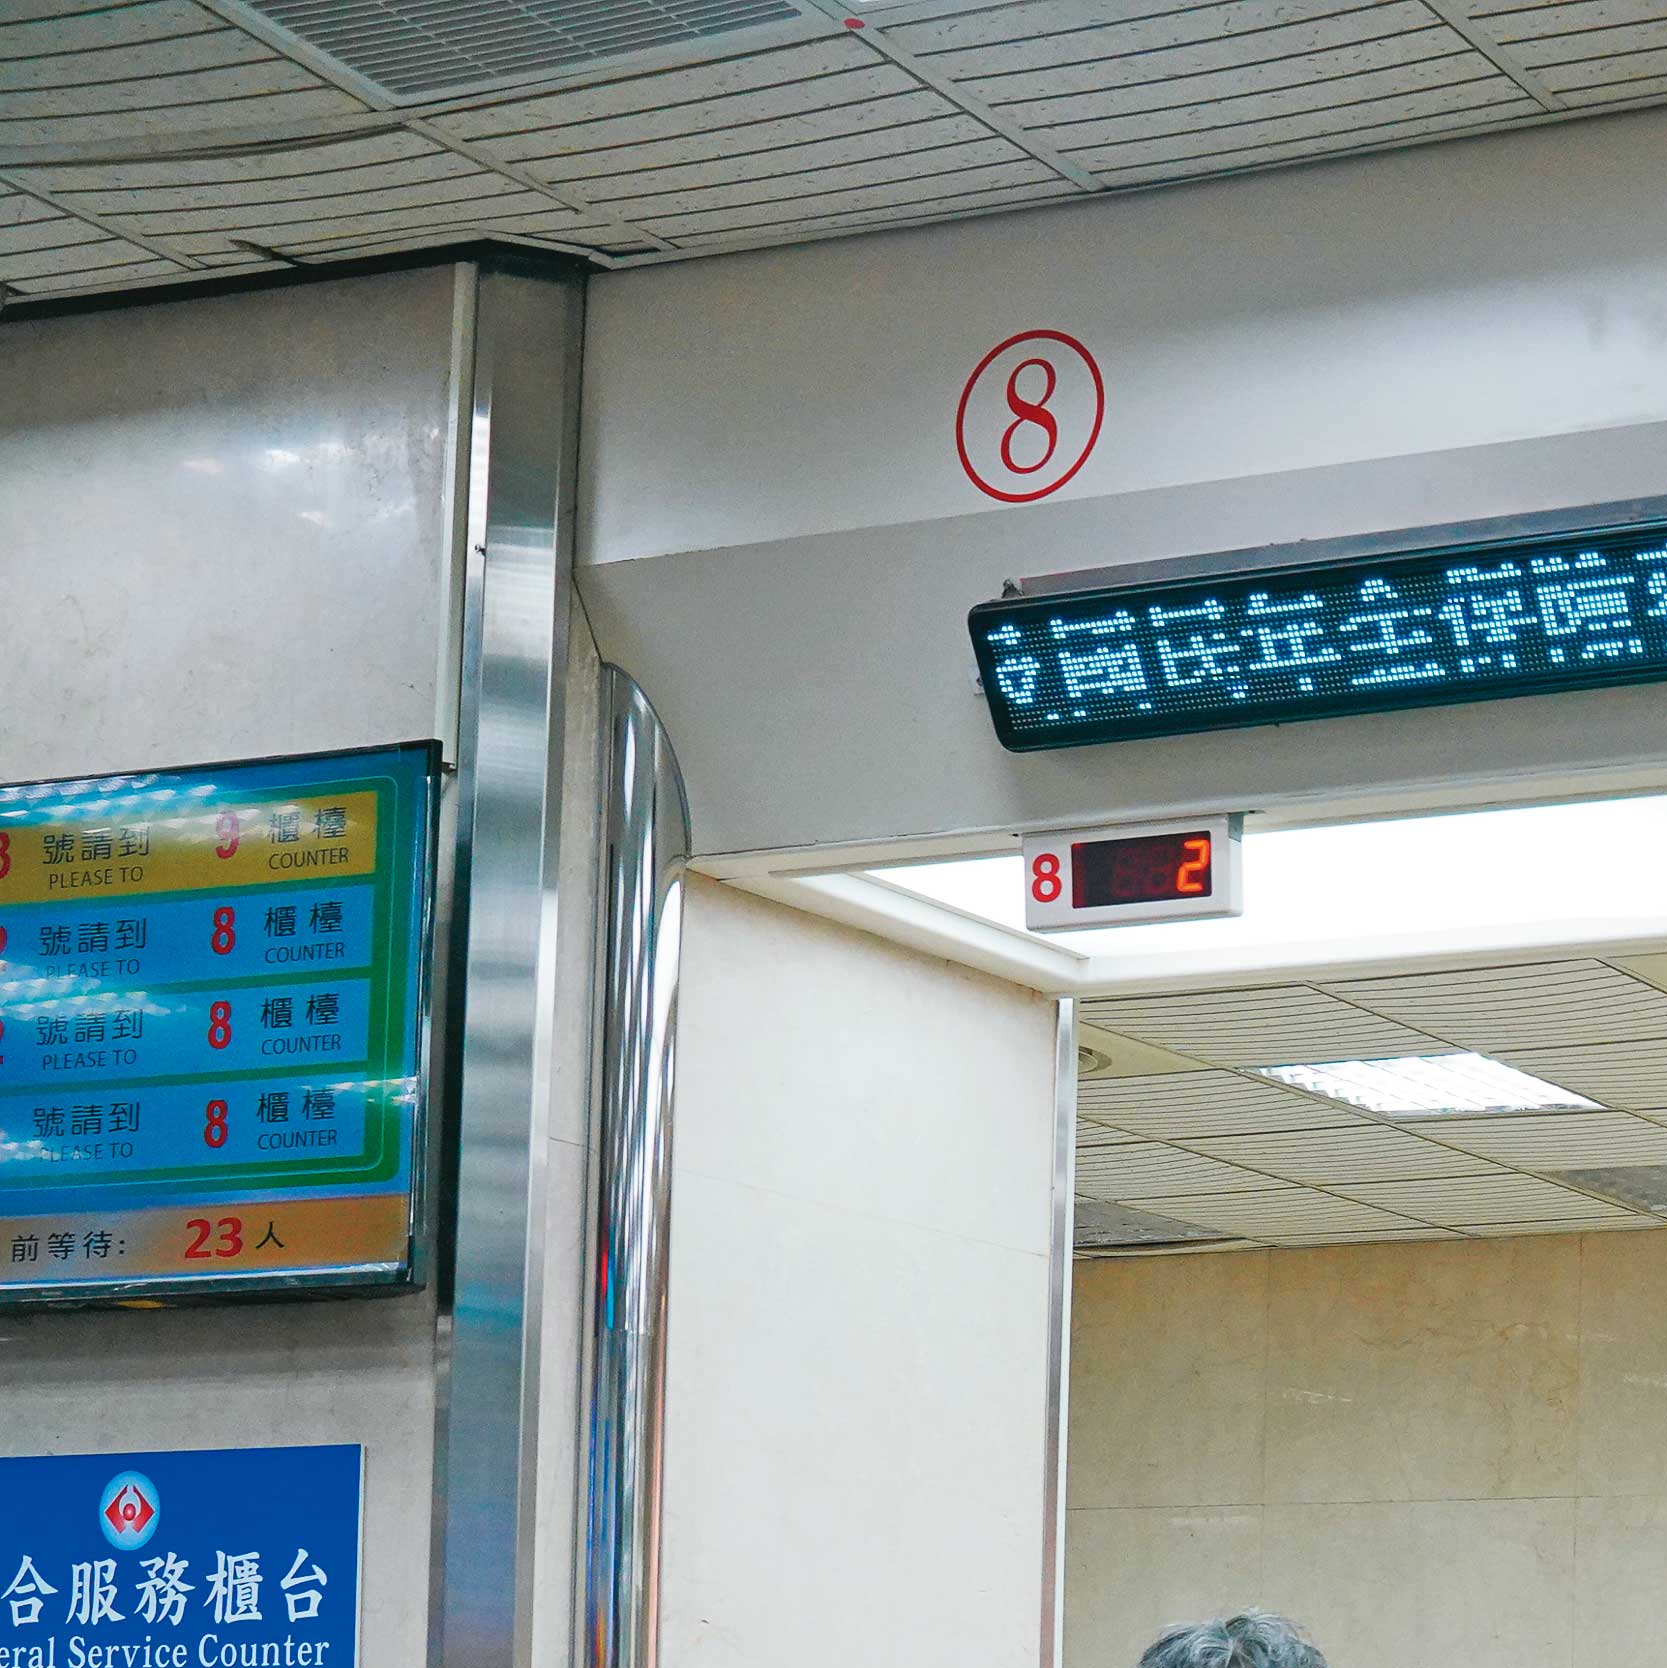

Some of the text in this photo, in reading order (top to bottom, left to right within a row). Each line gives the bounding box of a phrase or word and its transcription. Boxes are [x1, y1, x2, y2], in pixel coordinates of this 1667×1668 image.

[1000, 358, 1058, 474] 8
[43, 826, 149, 864] 號請到
[216, 810, 239, 859] 9
[269, 807, 347, 843] 櫃檯
[50, 848, 349, 889] PLEASE TO COUNTER
[1031, 853, 1063, 904] 8
[1176, 839, 1210, 892] 2
[40, 918, 146, 956] 號請到
[211, 907, 236, 955] 8
[264, 901, 343, 937] 櫃檯
[47, 942, 344, 978] PLEASE TO COUNTER
[36, 1009, 143, 1045] 號請到
[208, 1001, 231, 1049] 8
[260, 993, 340, 1029] 櫃檯
[43, 1034, 341, 1070] PLEASE TO COUNTER
[33, 1088, 335, 1148] 號請到 8 櫃檯
[40, 1129, 336, 1163] PLEASE TO COUNTER
[185, 1217, 243, 1258] 23
[255, 1221, 285, 1249] 人
[2, 1548, 327, 1626] 合服務櫃台
[199, 1633, 329, 1668] Counter
